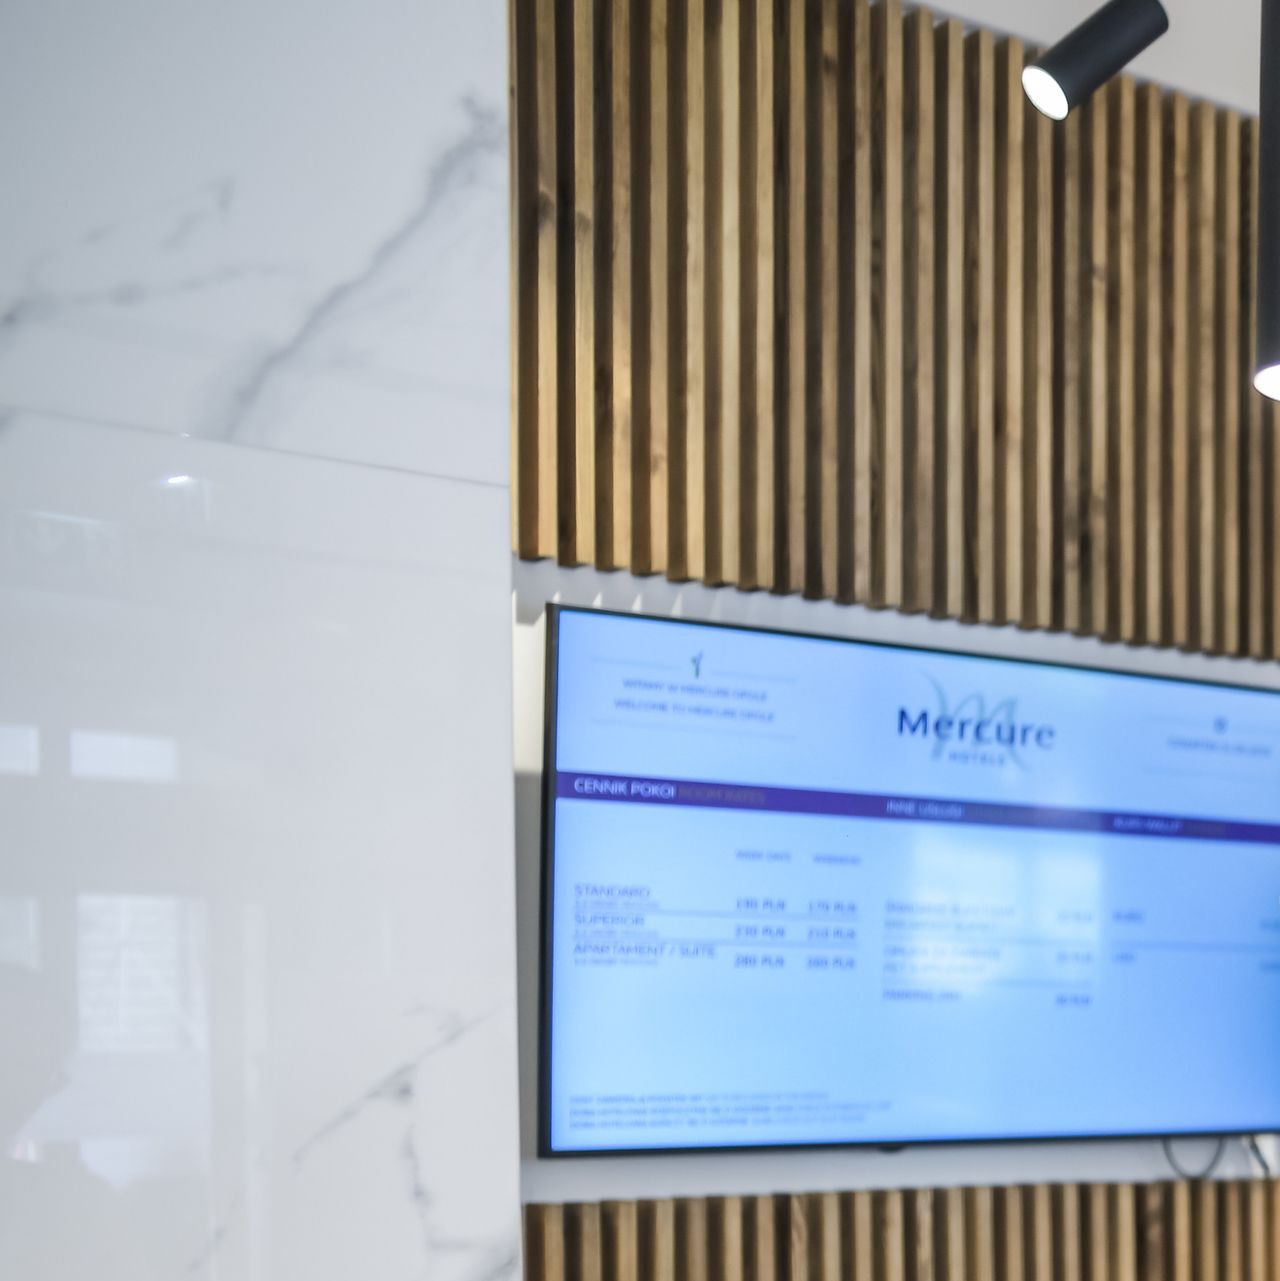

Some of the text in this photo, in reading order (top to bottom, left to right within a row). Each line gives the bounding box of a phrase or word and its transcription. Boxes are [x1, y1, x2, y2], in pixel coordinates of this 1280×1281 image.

[897, 706, 1056, 749] Mercure
[574, 777, 627, 796] CENNIK
[630, 781, 677, 799] POKOI
